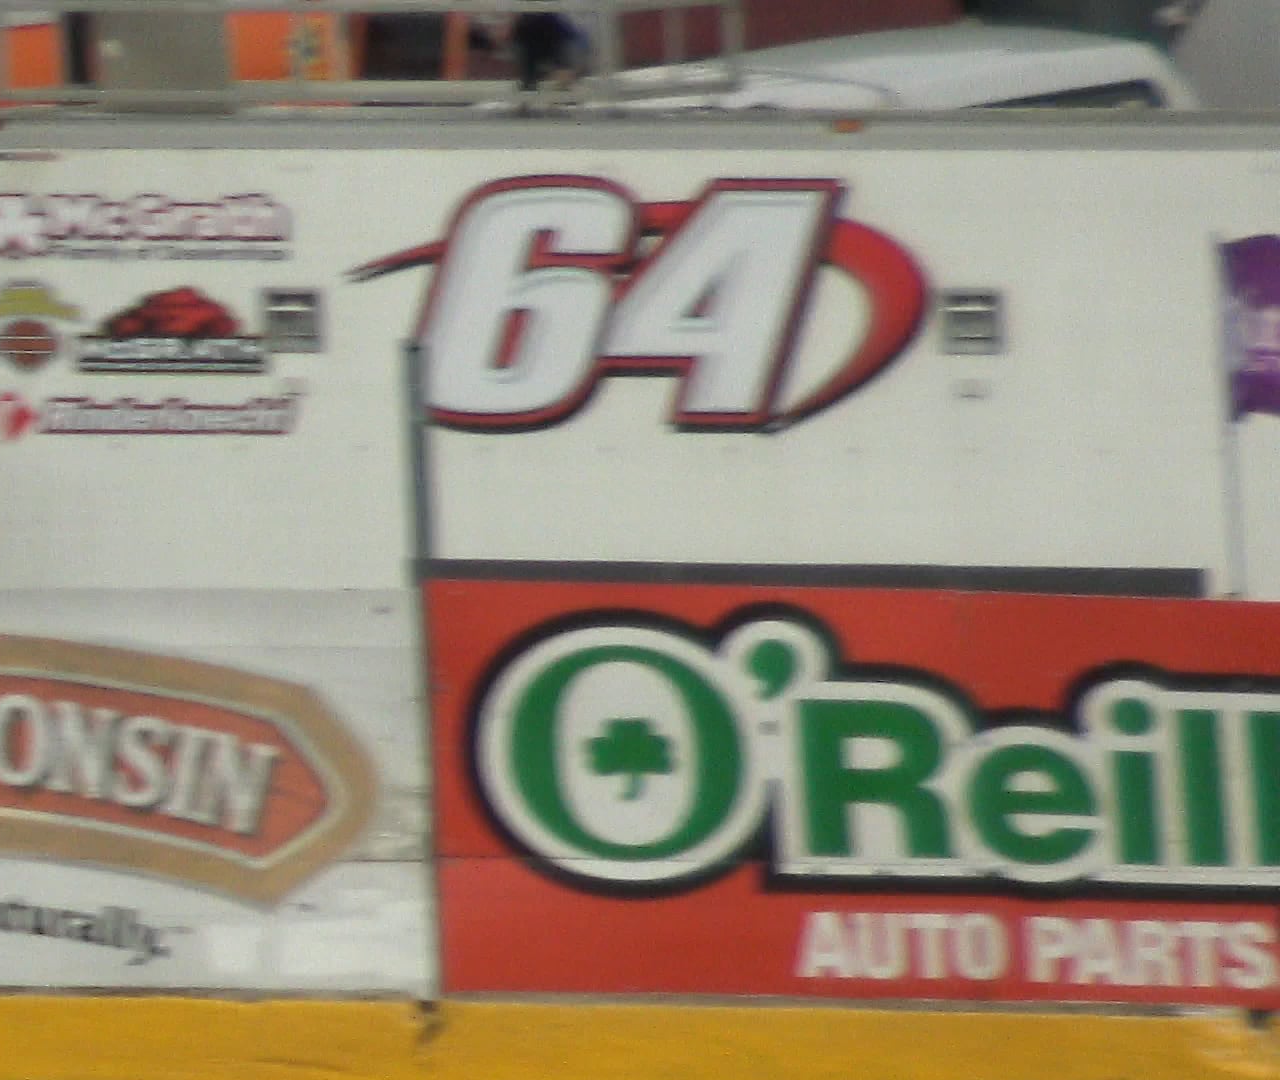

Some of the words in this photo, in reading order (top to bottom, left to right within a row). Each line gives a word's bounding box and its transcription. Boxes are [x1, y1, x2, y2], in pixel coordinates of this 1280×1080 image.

[422, 174, 844, 432] 64
[792, 911, 1008, 981] AUTO
[1024, 914, 1279, 990] PARTS
